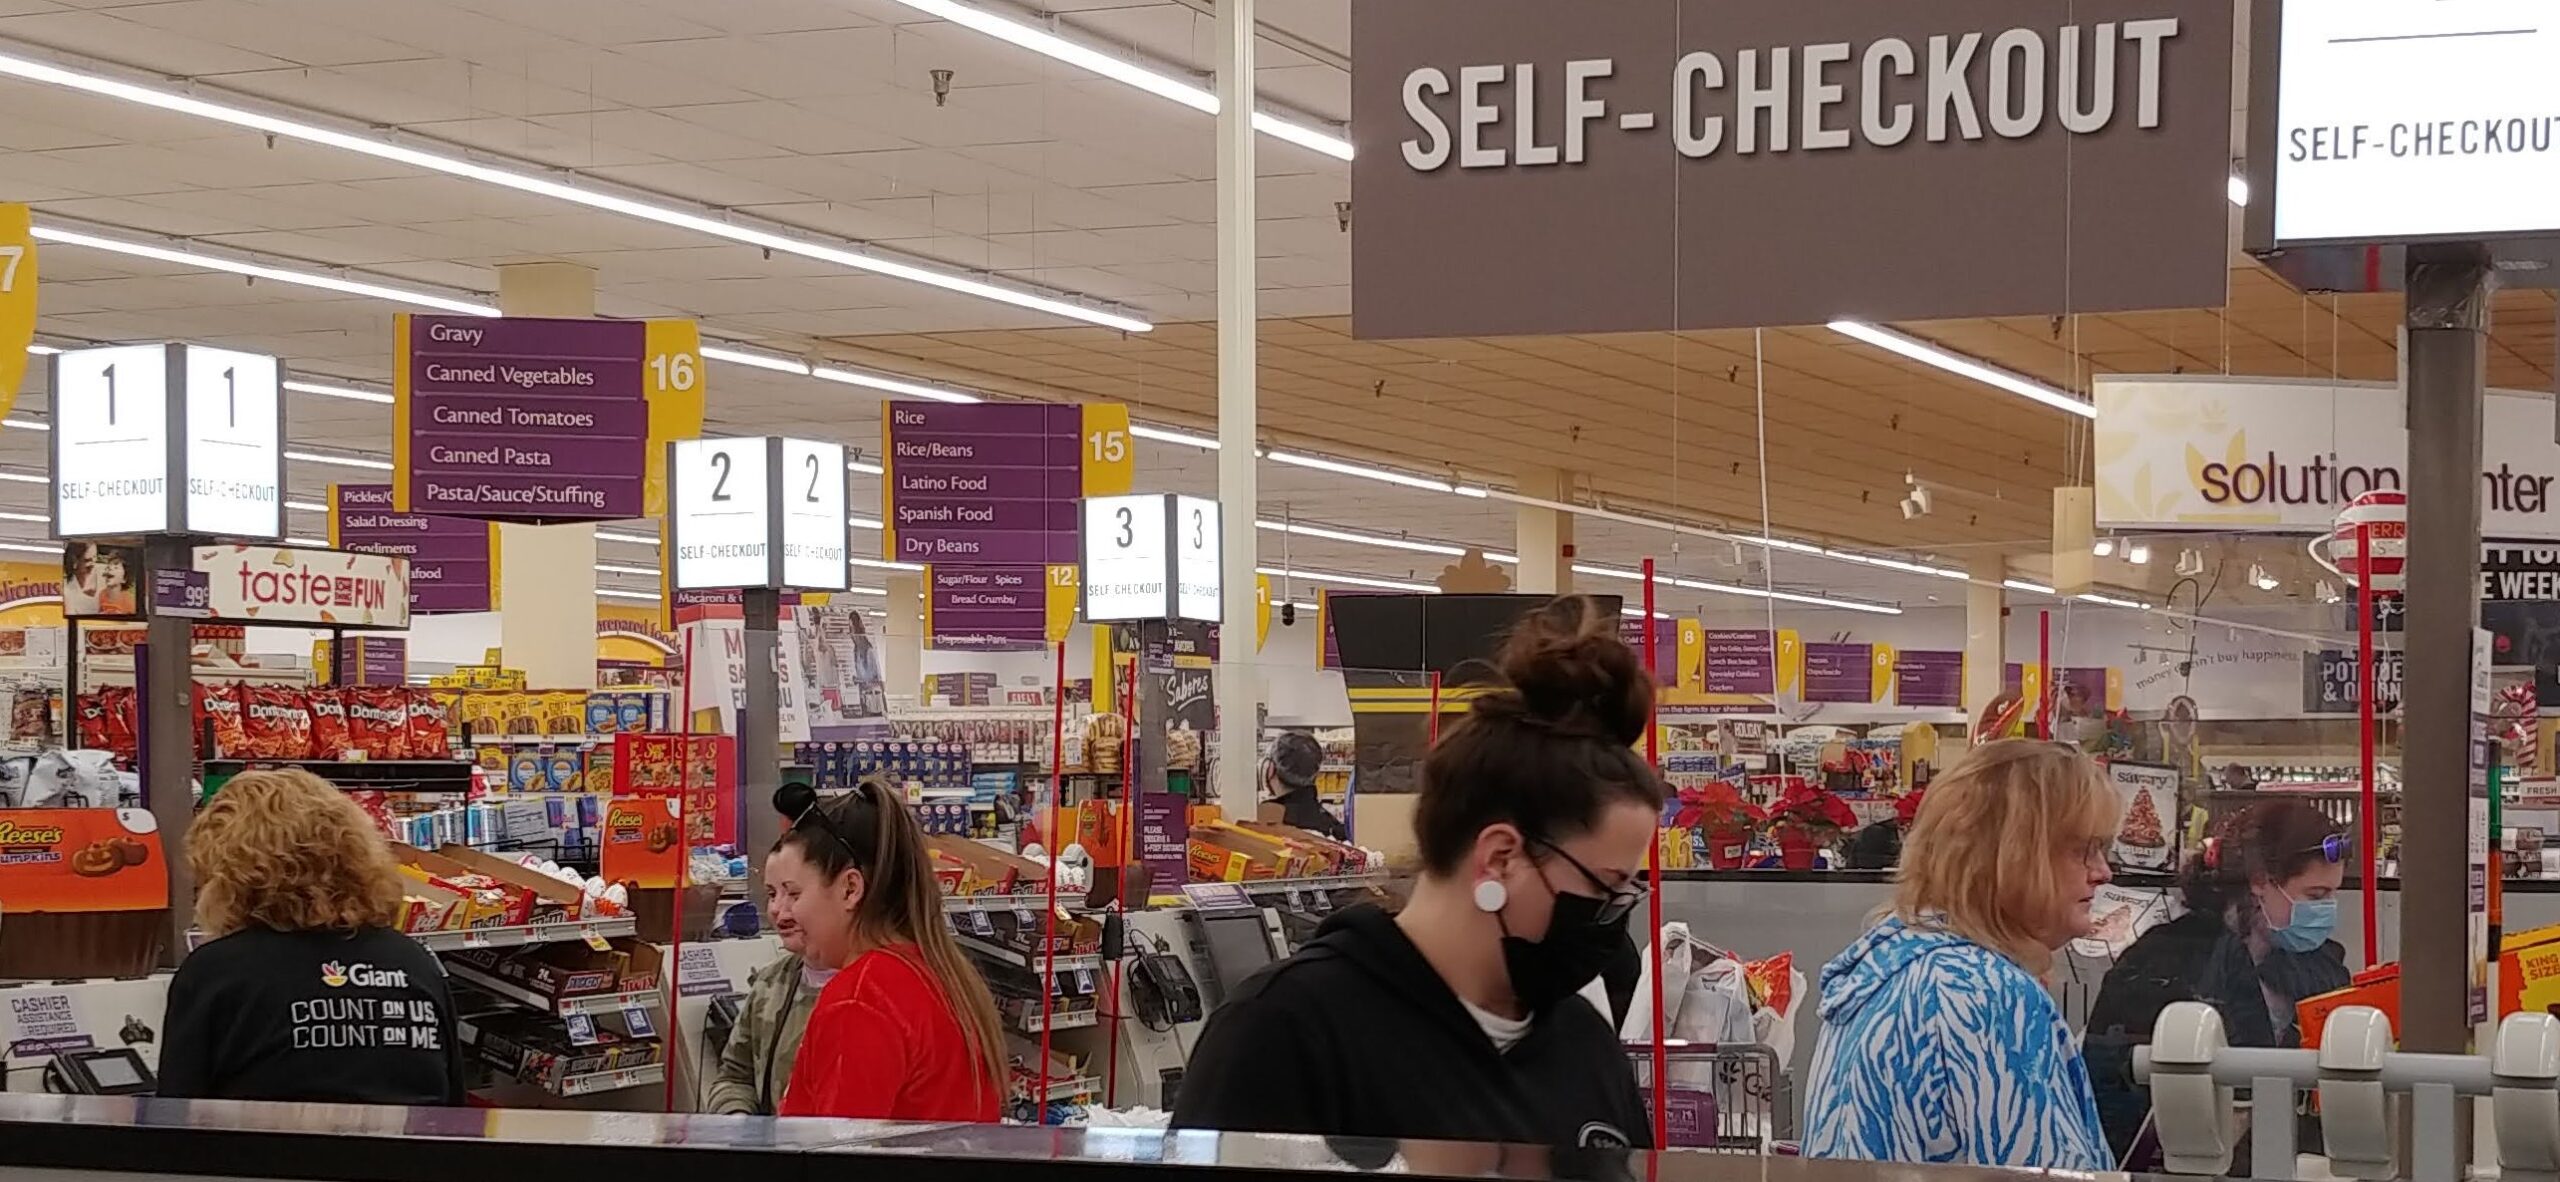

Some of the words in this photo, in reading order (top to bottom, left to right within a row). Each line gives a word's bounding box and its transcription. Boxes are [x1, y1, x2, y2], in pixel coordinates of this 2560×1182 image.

[1401, 17, 2181, 173] SELF-CHECKOUT
[2289, 116, 2560, 162] SELF-CHECKOU
[430, 324, 483, 346] Gravy
[426, 365, 495, 383] Canned
[501, 366, 594, 388] Vegetables
[650, 353, 694, 391] 16
[102, 364, 116, 425] 1
[223, 367, 235, 428] 1
[434, 406, 502, 425] Canned
[508, 408, 593, 427] Tomatoes
[895, 411, 925, 425] Rice
[430, 446, 499, 465] Canned
[504, 448, 551, 466] Pasta
[897, 443, 973, 459] Rice/Beans
[1089, 431, 1125, 462] 15
[711, 451, 731, 501] 2
[805, 453, 820, 502] 2
[902, 475, 947, 491] Latino
[951, 475, 988, 490] Food
[62, 477, 164, 500] SELF-CHECKOUT
[427, 483, 605, 507] Pasta/Sauce/Stuffing
[346, 516, 376, 528] Salad
[379, 516, 429, 530] Dressing
[899, 506, 953, 523] Spanish
[957, 507, 993, 521] Food
[1115, 507, 1133, 548] 3
[1193, 508, 1203, 549] 3
[346, 542, 417, 555] Condiments
[680, 542, 766, 559] SELF-CHECKOUT
[906, 538, 933, 556] Dry
[937, 538, 980, 553] Beans
[238, 560, 331, 606] taste
[937, 575, 988, 586] Sugar/Flour
[995, 574, 1023, 587] Spices
[1050, 567, 1073, 587] 12
[355, 577, 386, 609] FUN
[677, 592, 725, 604] Macaroni
[727, 593, 738, 603] &
[951, 595, 976, 604] Bread
[1684, 630, 1694, 644] 8
[1783, 640, 1792, 653] 7
[1877, 653, 1887, 666] 6
[2217, 652, 2239, 664] buy
[2026, 671, 2036, 684] 4
[2136, 669, 2172, 690] money
[1166, 675, 1209, 706] Sabores
[2324, 682, 2337, 701] &
[2527, 786, 2557, 794] FRESH
[122, 812, 130, 821] $
[2526, 954, 2559, 969] KING
[350, 963, 409, 988] Giant
[2530, 966, 2560, 981] SIZE
[12, 995, 70, 1013] CASHIER
[291, 998, 378, 1023] COUNT
[382, 1000, 405, 1019] ON
[408, 1000, 439, 1027] US,
[17, 1011, 73, 1024] ASSISTANCE
[293, 1024, 379, 1048] COUNT
[383, 1026, 407, 1045] ON
